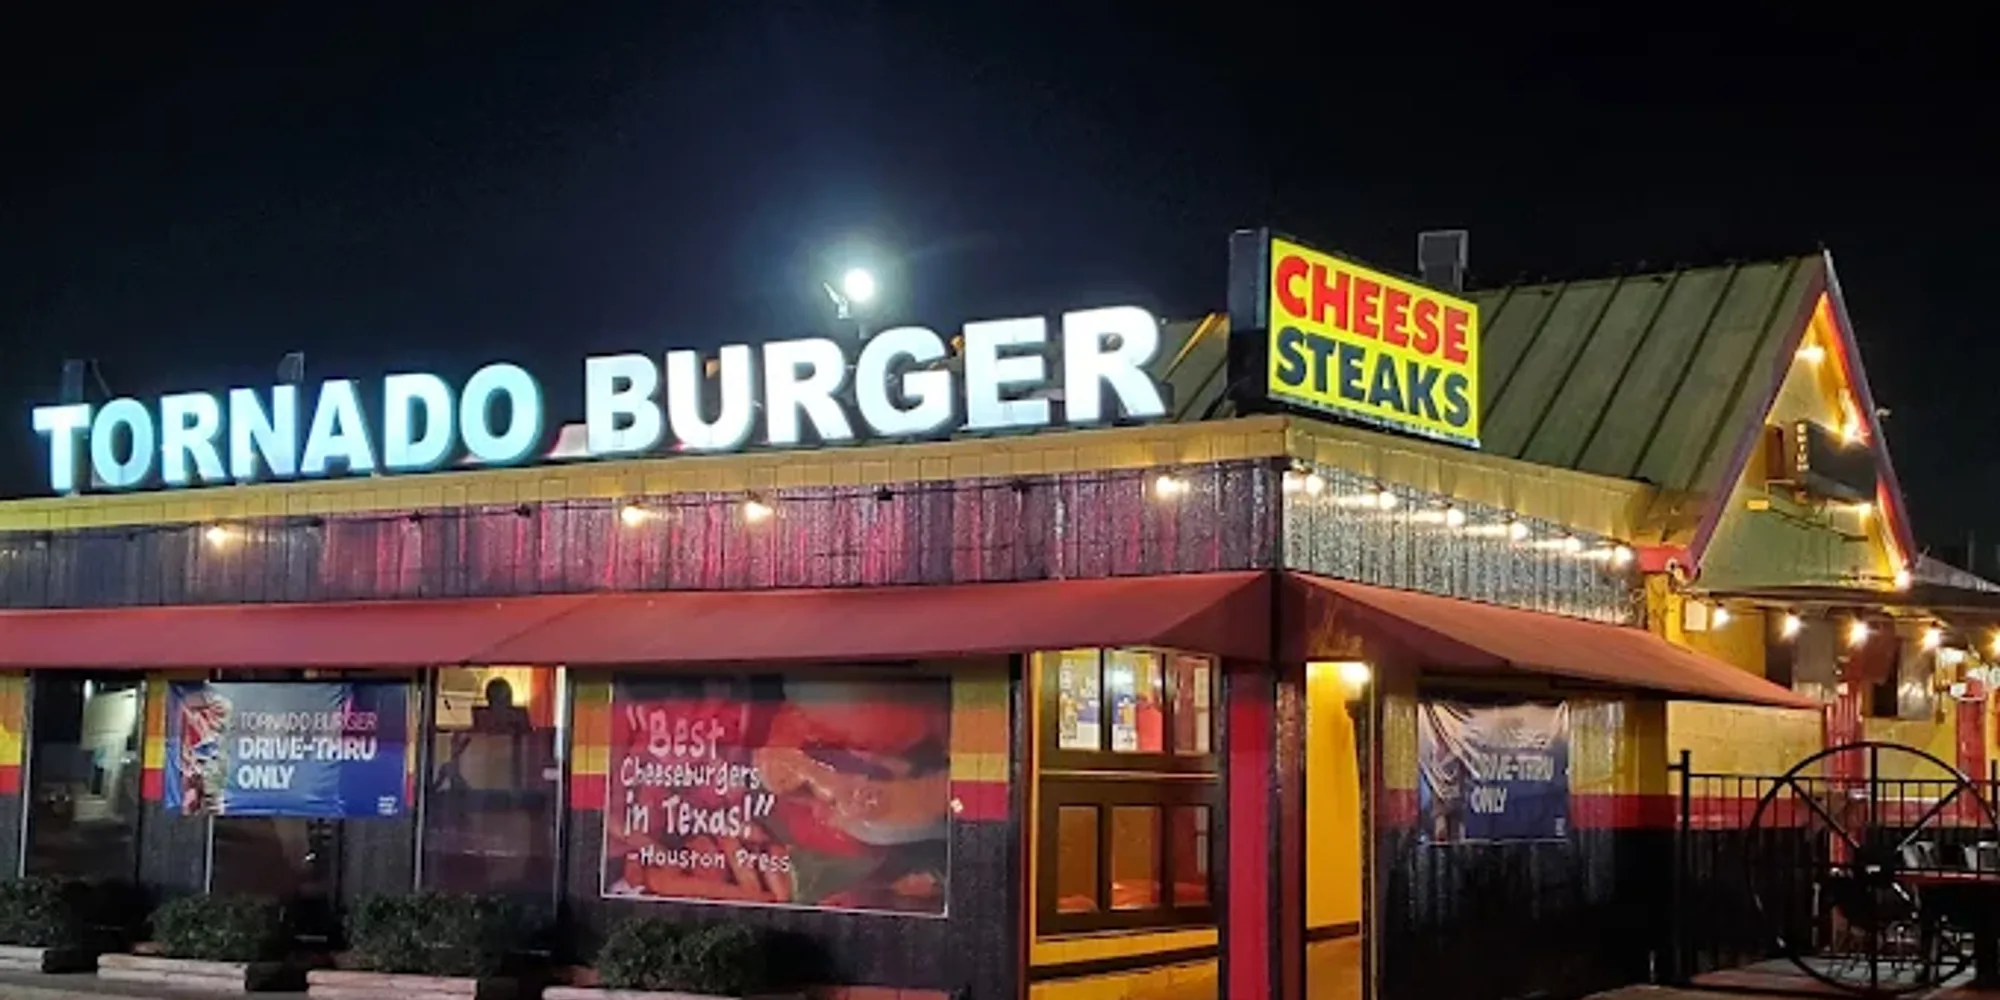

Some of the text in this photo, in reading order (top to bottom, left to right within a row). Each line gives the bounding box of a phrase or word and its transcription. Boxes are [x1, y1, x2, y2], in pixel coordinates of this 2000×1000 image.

[1275, 255, 1470, 365] CHEESE
[1275, 326, 1471, 428] STEAKS
[33, 305, 1167, 492] TORNADO BURGER
[240, 711, 378, 731] TORNADO BURGER
[238, 736, 377, 761] DRIVE-THRU
[237, 764, 295, 789] ONLY
[620, 755, 762, 796] Cheeseburgers
[624, 789, 775, 839] in Texas!"
[735, 848, 792, 873] Press
